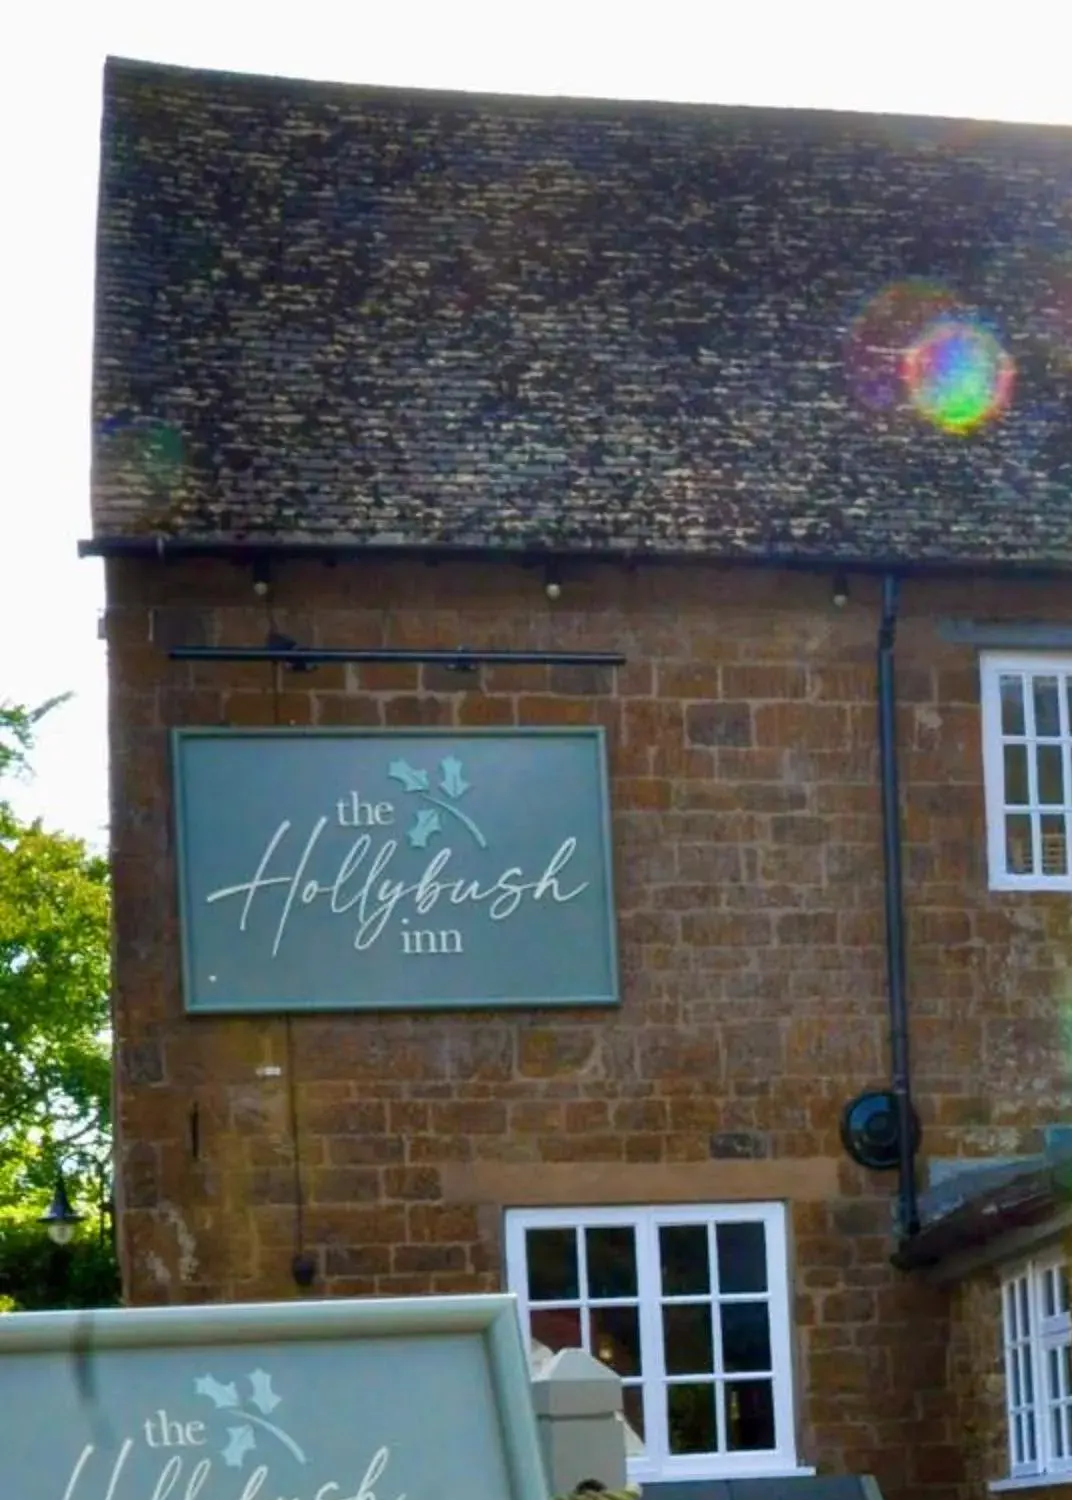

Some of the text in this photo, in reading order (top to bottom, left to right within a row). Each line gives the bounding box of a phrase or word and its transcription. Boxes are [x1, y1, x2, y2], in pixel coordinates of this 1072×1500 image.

[337, 791, 395, 827] the
[206, 815, 590, 957] Hollybush
[400, 918, 464, 954] inn
[144, 1410, 206, 1448] the
